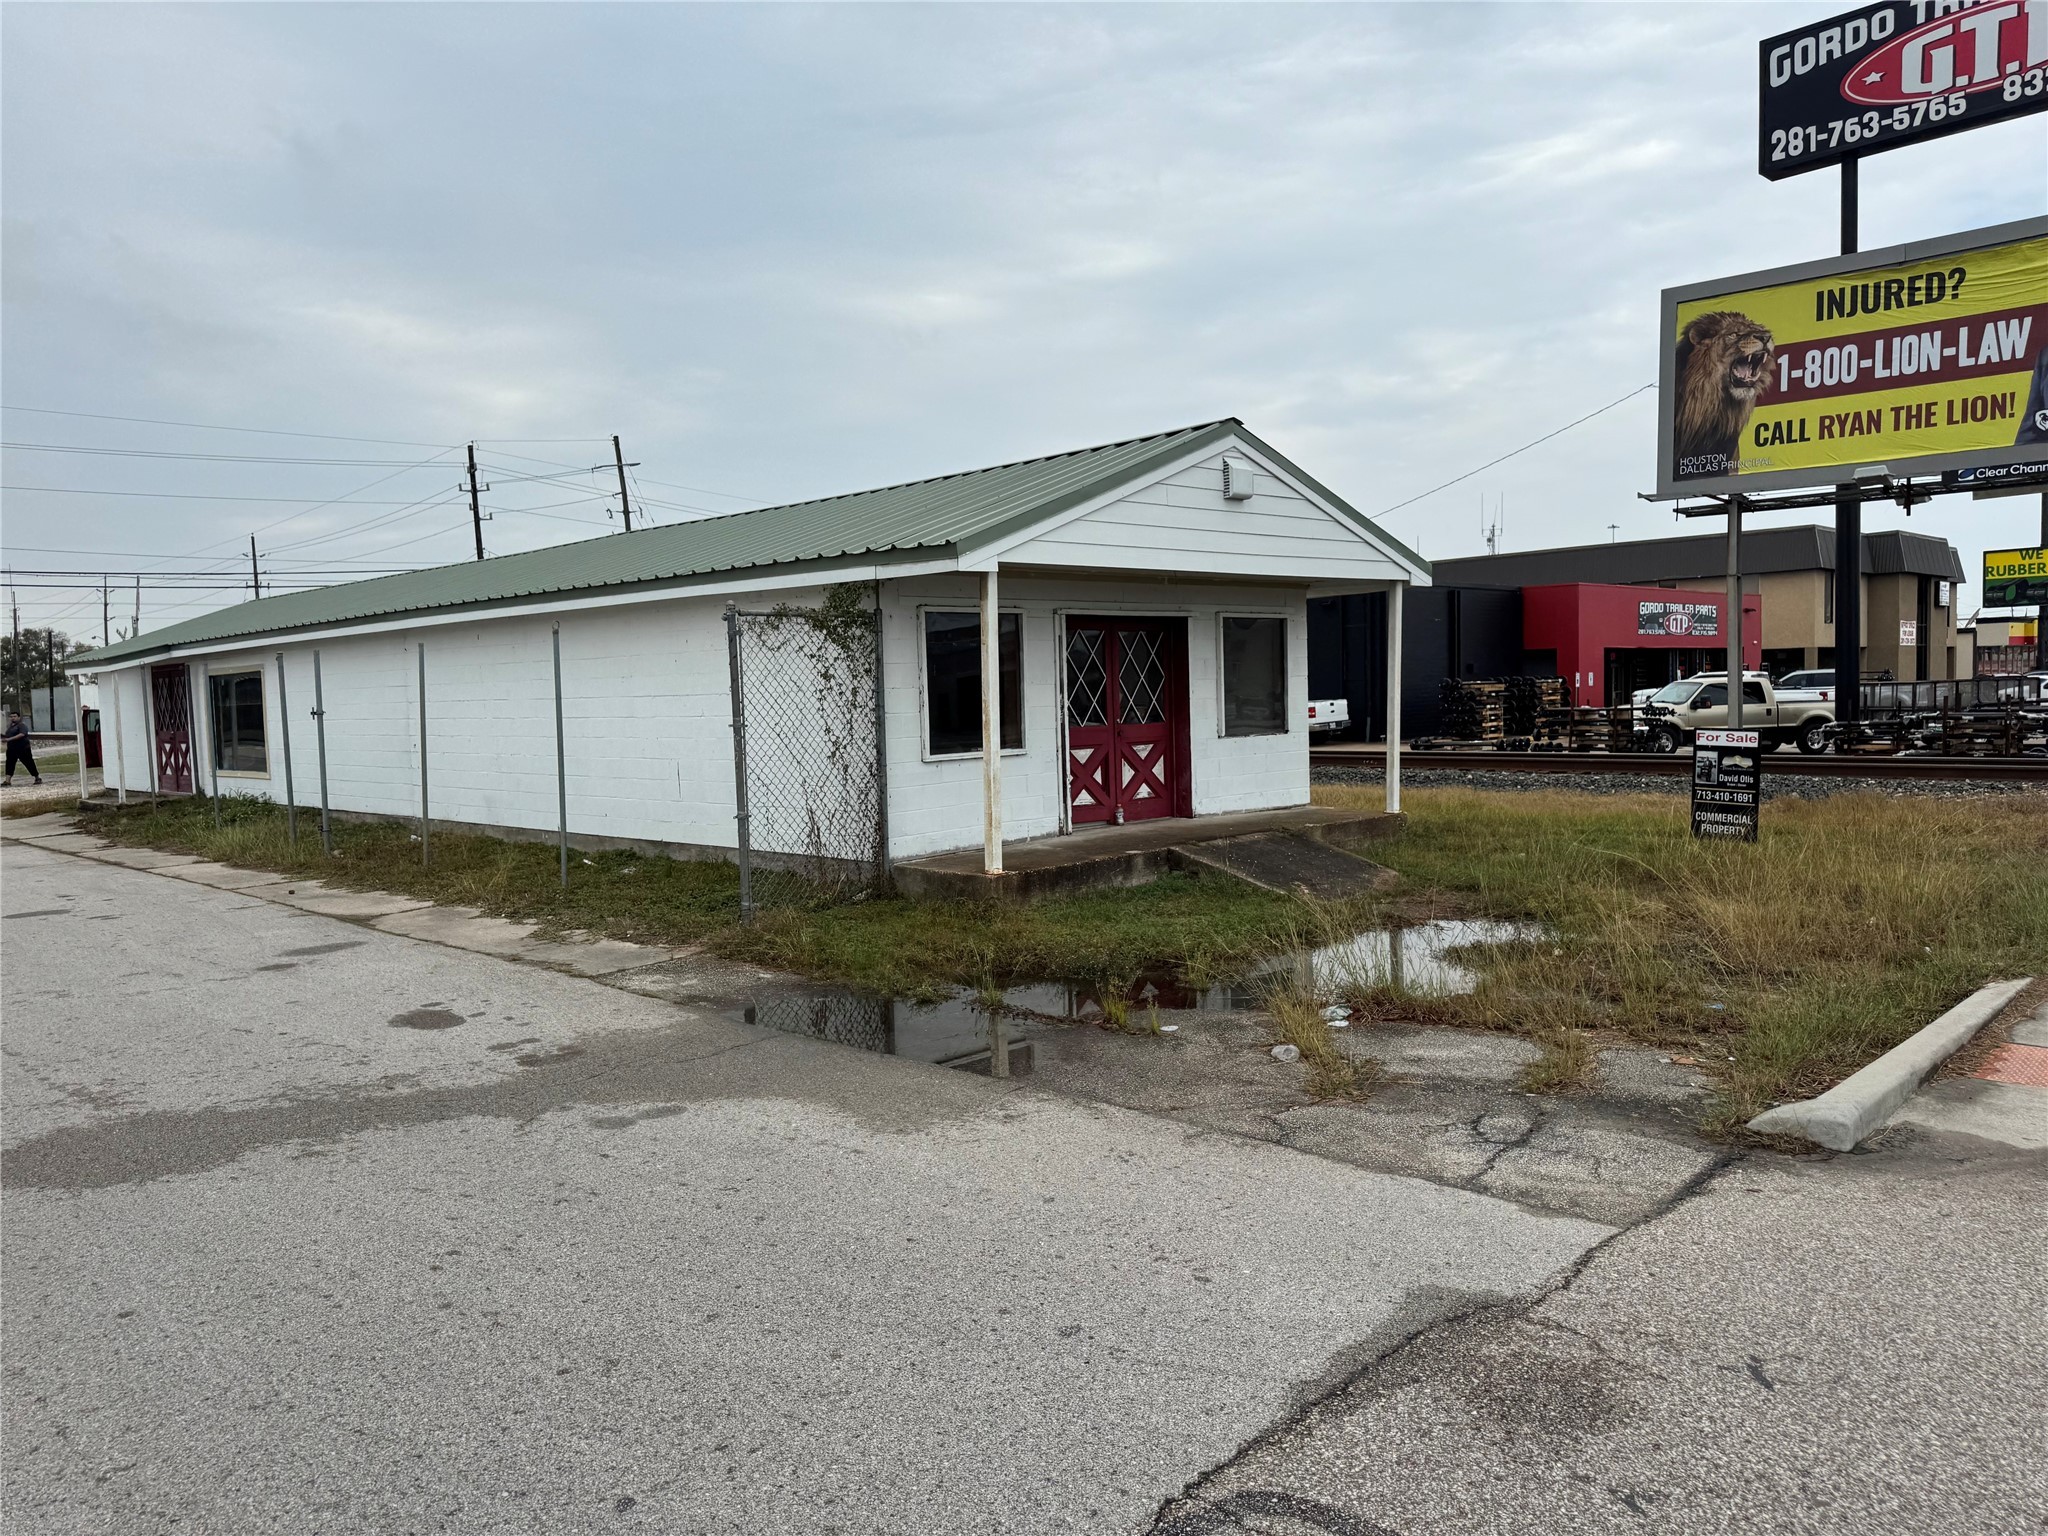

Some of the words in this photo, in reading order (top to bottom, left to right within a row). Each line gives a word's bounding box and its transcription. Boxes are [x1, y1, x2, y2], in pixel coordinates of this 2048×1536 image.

[1769, 8, 1895, 88] GORDO
[1771, 91, 1967, 162] 281-763-5765
[2003, 66, 2048, 102] 83
[1816, 267, 1967, 322] INJURED?
[1777, 316, 2033, 392] 1-800-LION-LAW
[1754, 418, 1811, 447] CALL
[1818, 408, 1882, 440] RYAN
[1890, 401, 1939, 432] THE
[1946, 391, 2016, 426] LION!
[1680, 453, 1727, 466] HOUSTON
[1680, 463, 1719, 475] DALLAS
[1721, 457, 1775, 470] PRINCIPAL
[1976, 467, 2009, 478] Clear
[2018, 549, 2044, 561] WE
[1986, 562, 2048, 578] RUBBER
[1640, 602, 1664, 615] GORDO
[1665, 603, 1694, 614] TRAILER
[1695, 604, 1717, 618] PARTS
[1697, 732, 1721, 742] For
[1725, 733, 1758, 744] Sale
[1719, 773, 1739, 782] David
[1740, 774, 1754, 784] Otis
[1696, 790, 1753, 803] 713-410-1691
[1695, 811, 1753, 825] COMMERCIAL
[1701, 823, 1746, 836] PROPERTY
